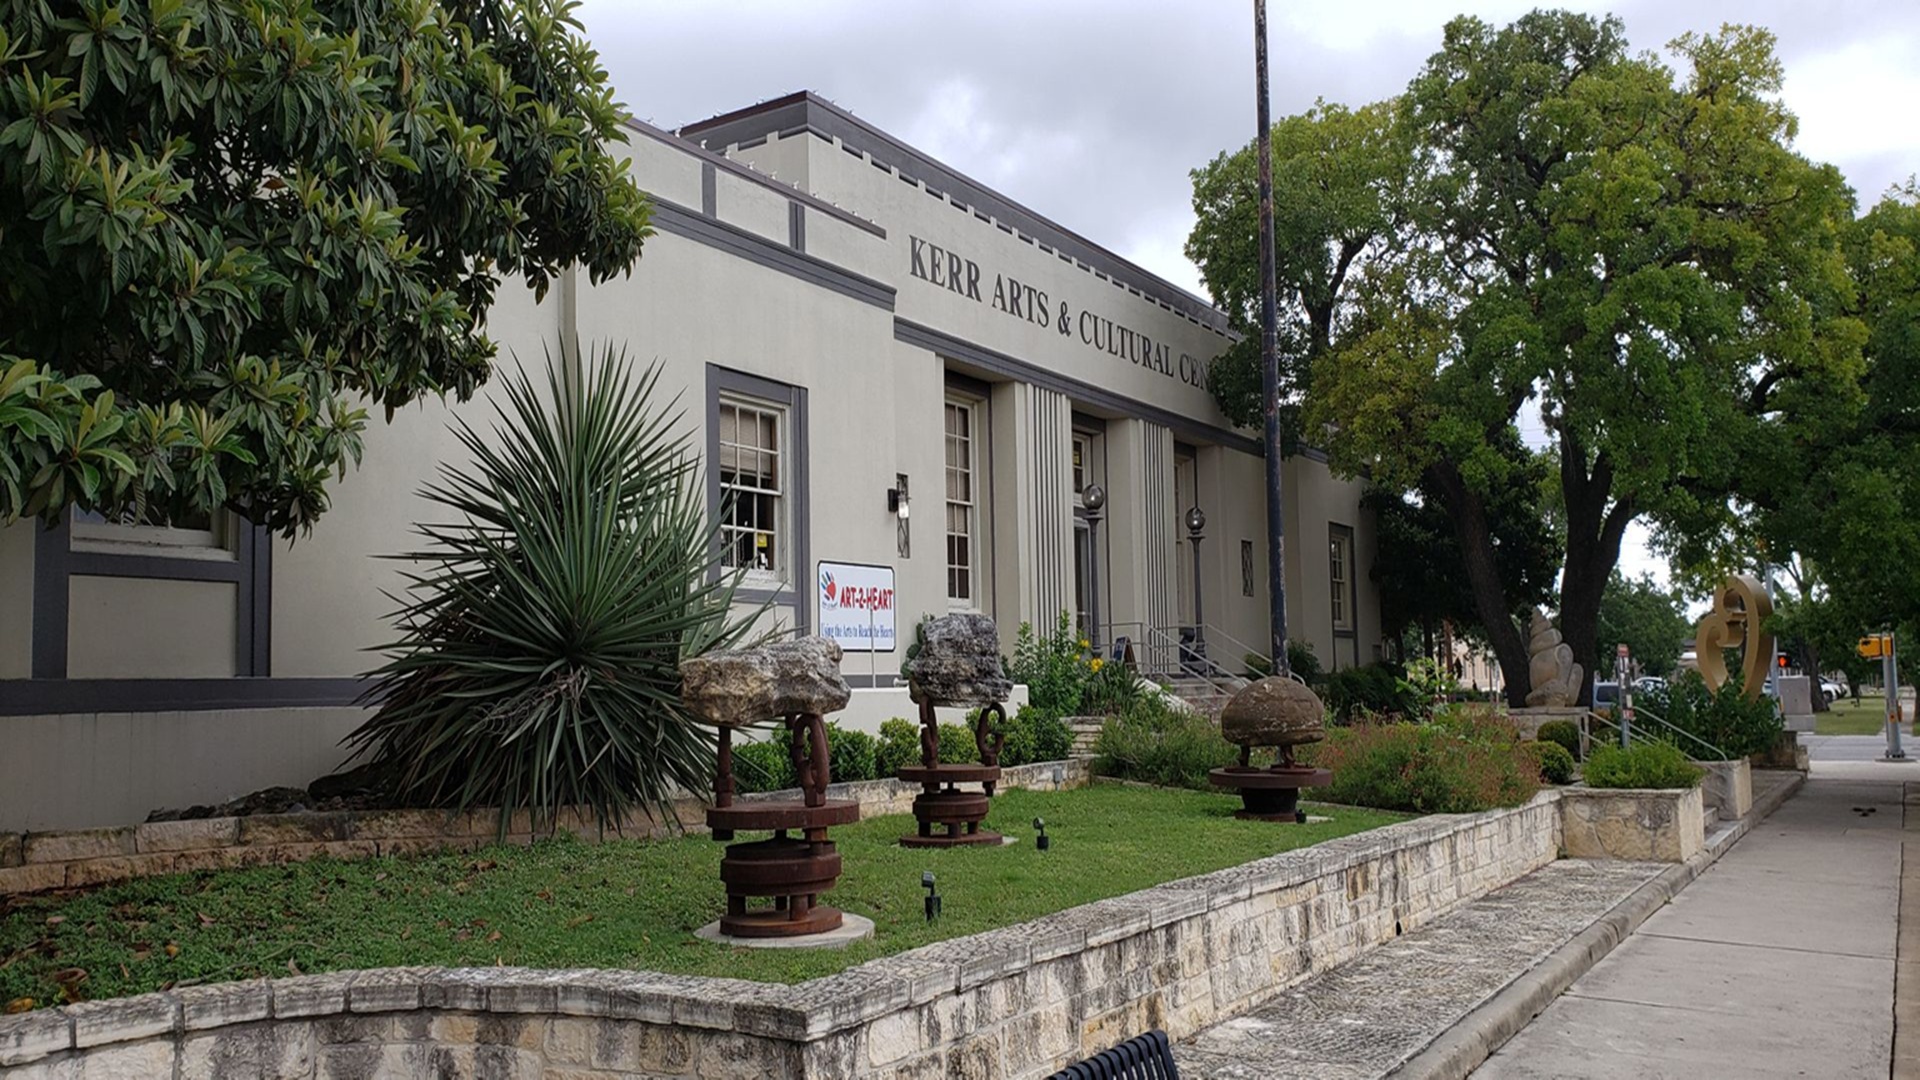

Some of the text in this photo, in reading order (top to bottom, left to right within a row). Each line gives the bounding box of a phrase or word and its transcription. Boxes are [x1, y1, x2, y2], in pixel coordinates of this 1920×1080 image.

[909, 234, 1211, 392] KERR ARTS & CULTURAL CEN
[840, 586, 893, 611] ART-2-HEART
